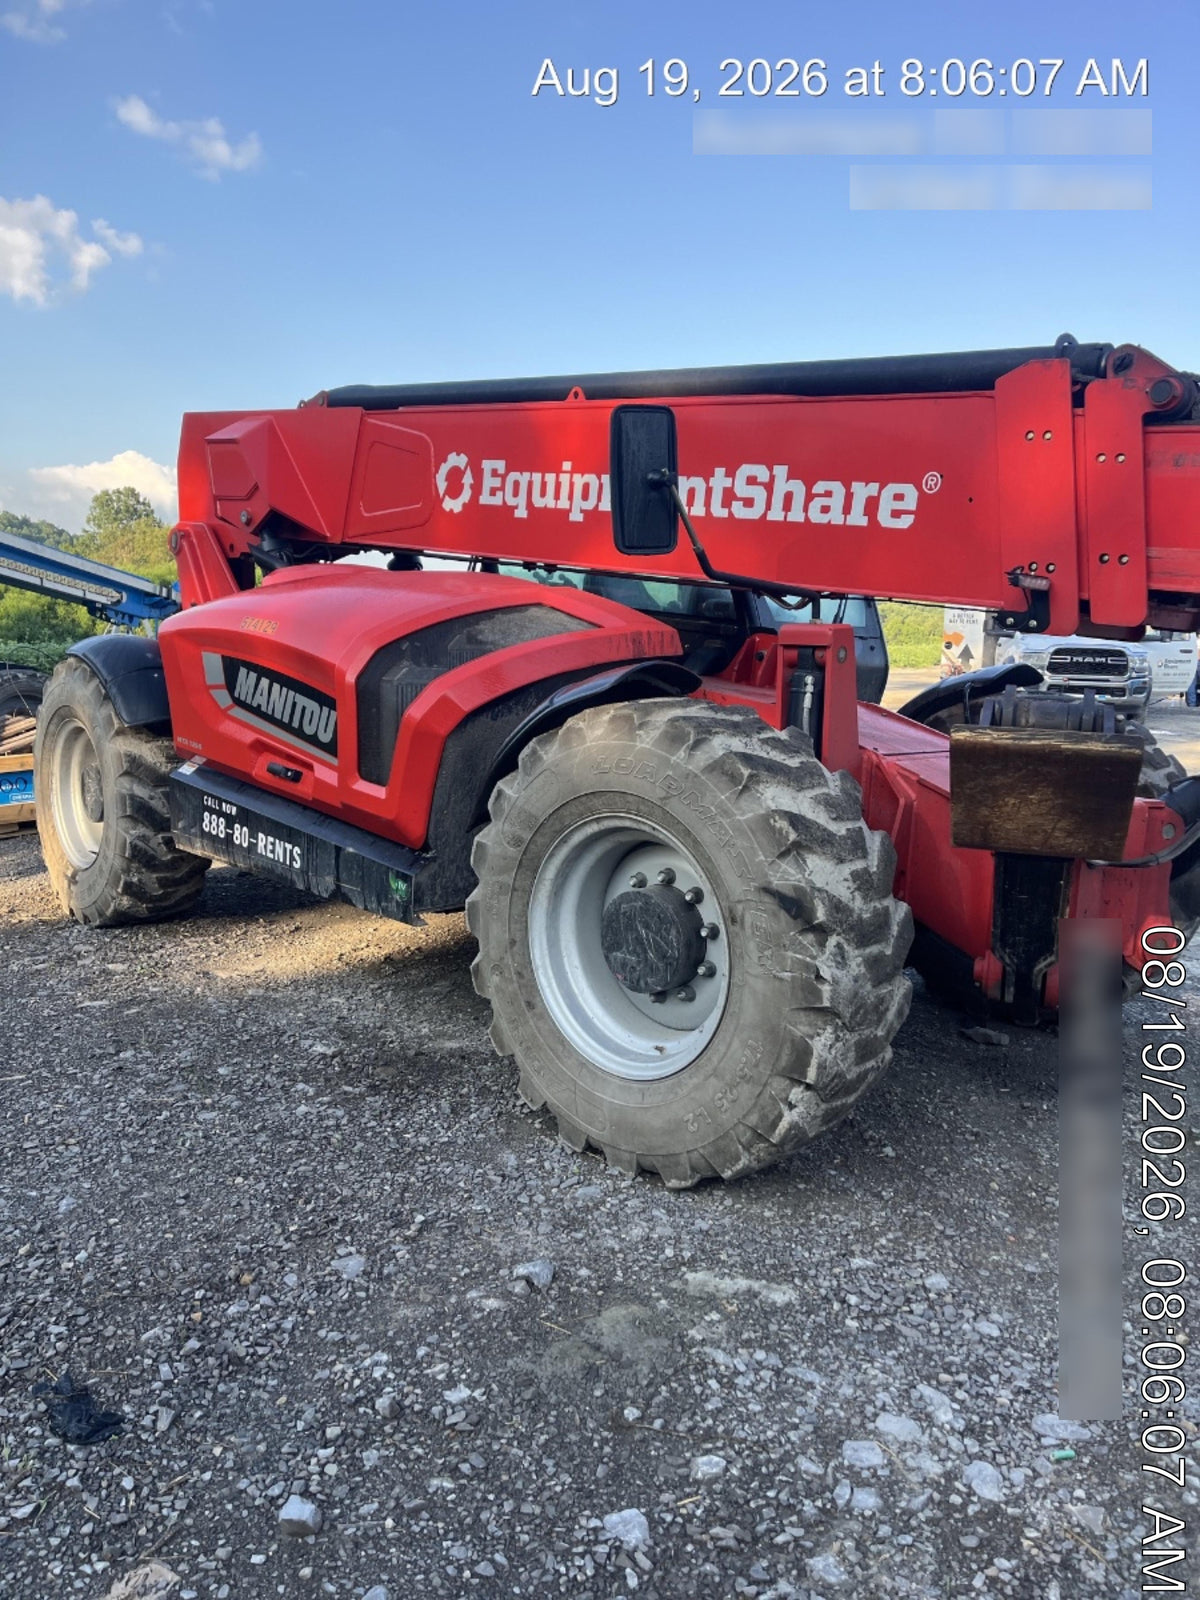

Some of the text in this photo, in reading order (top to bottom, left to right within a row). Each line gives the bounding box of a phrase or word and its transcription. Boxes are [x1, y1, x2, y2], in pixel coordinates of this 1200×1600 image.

[479, 460, 919, 530] EquipntShare
[1072, 656, 1107, 664] RAM
[233, 665, 337, 743] MANITOU
[203, 795, 237, 816] CALL NOW
[202, 811, 301, 869] 888-80-RENTS
